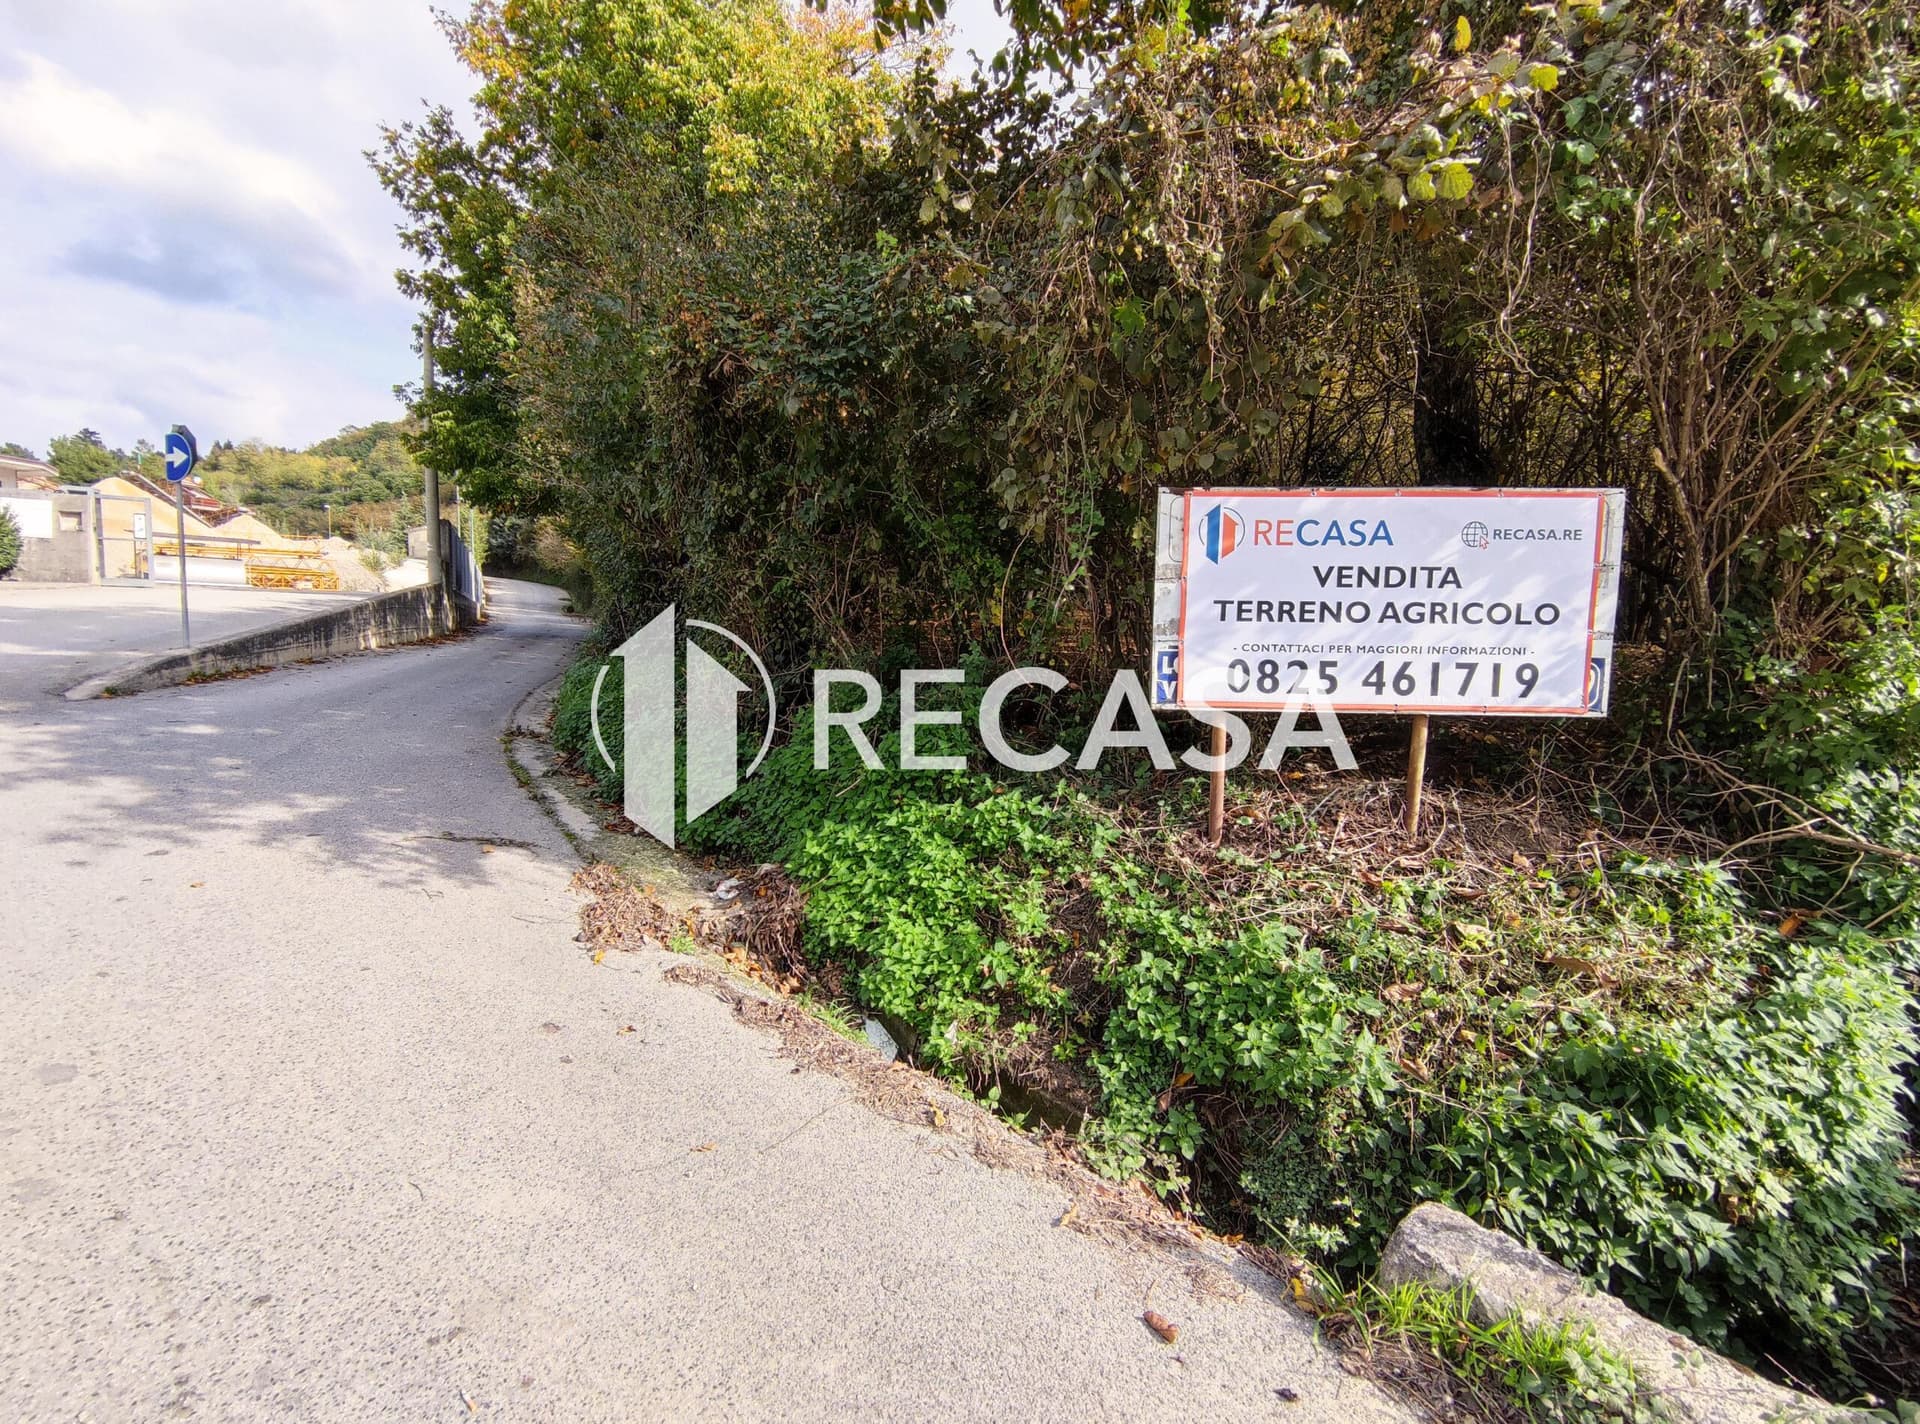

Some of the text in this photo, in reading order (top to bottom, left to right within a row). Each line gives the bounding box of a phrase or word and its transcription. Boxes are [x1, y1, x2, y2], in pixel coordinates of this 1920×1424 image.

[1253, 519, 1395, 547] RECASA
[1492, 528, 1583, 541] RECASA.RE
[1312, 565, 1463, 589] VENDITA
[1213, 599, 1561, 625] TERRENO AGRICOLO
[1241, 643, 1325, 653] CONTATTACI
[1328, 644, 1352, 654] PER
[1356, 645, 1423, 655] MAGGIORI
[1427, 645, 1527, 656] INFORMAZIONI
[1227, 658, 1540, 699] 0825 461719
